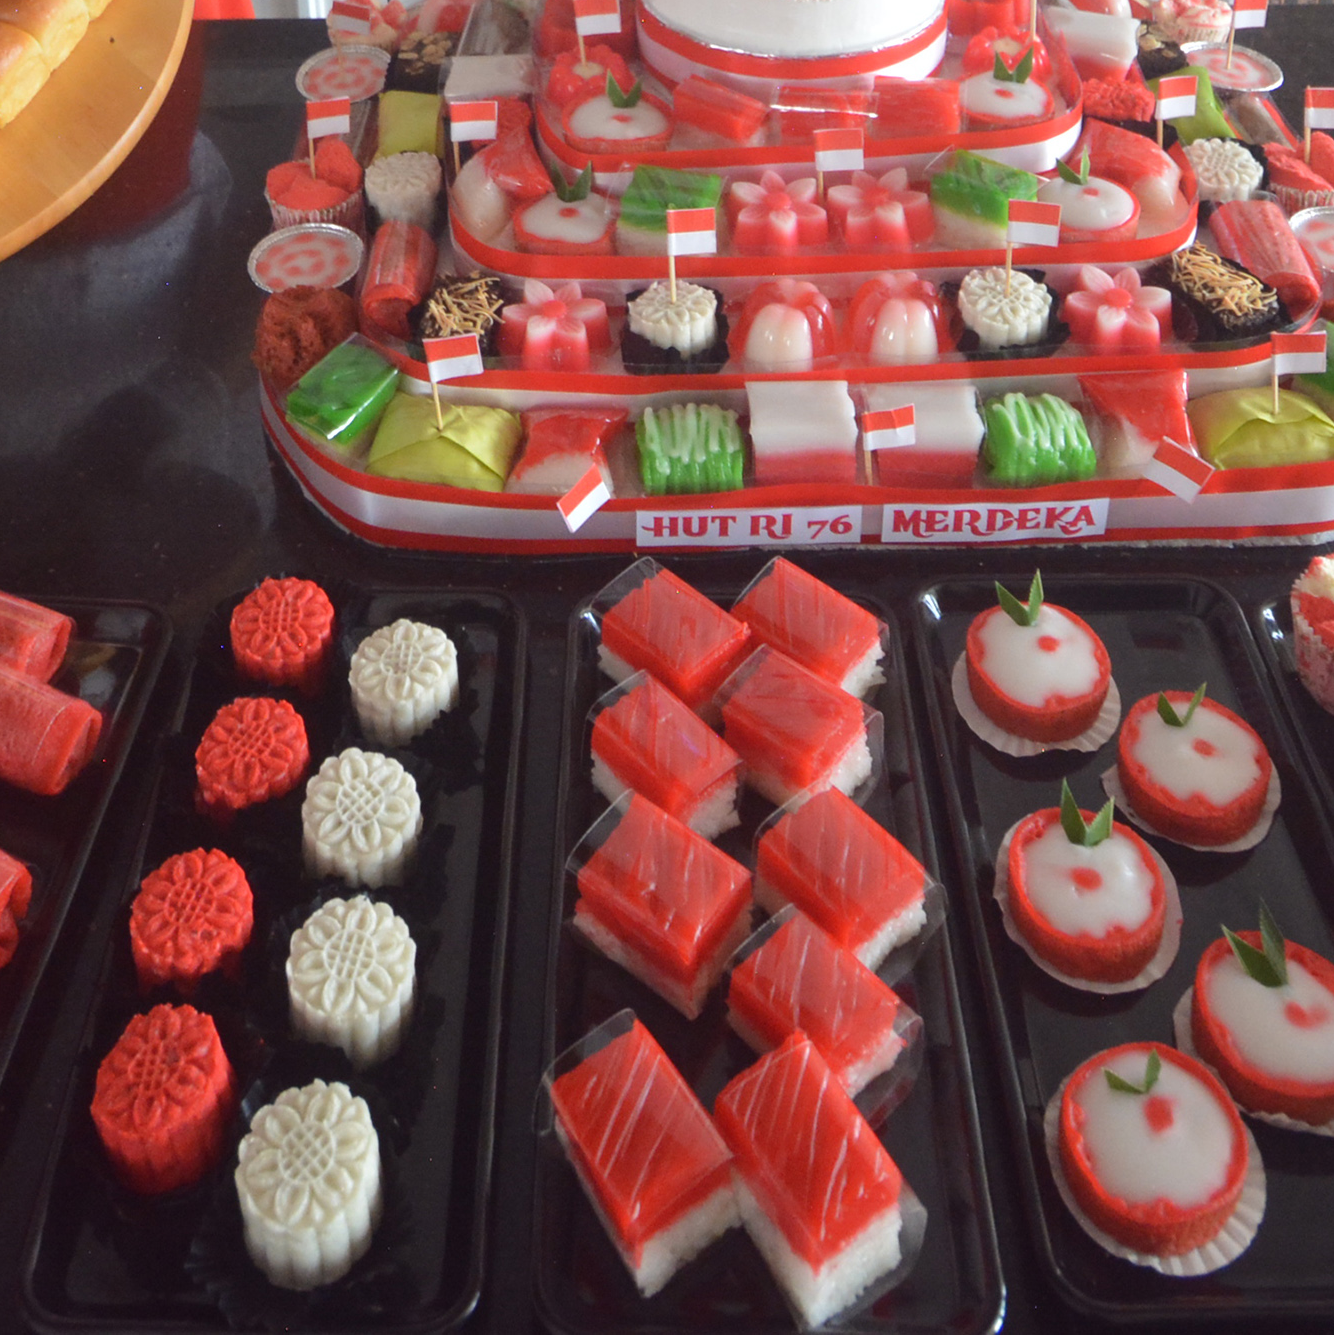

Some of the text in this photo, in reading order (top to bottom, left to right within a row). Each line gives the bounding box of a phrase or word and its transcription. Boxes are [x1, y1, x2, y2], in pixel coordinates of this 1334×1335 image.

[642, 505, 1096, 540] HUT RI 76 MERDEKA
